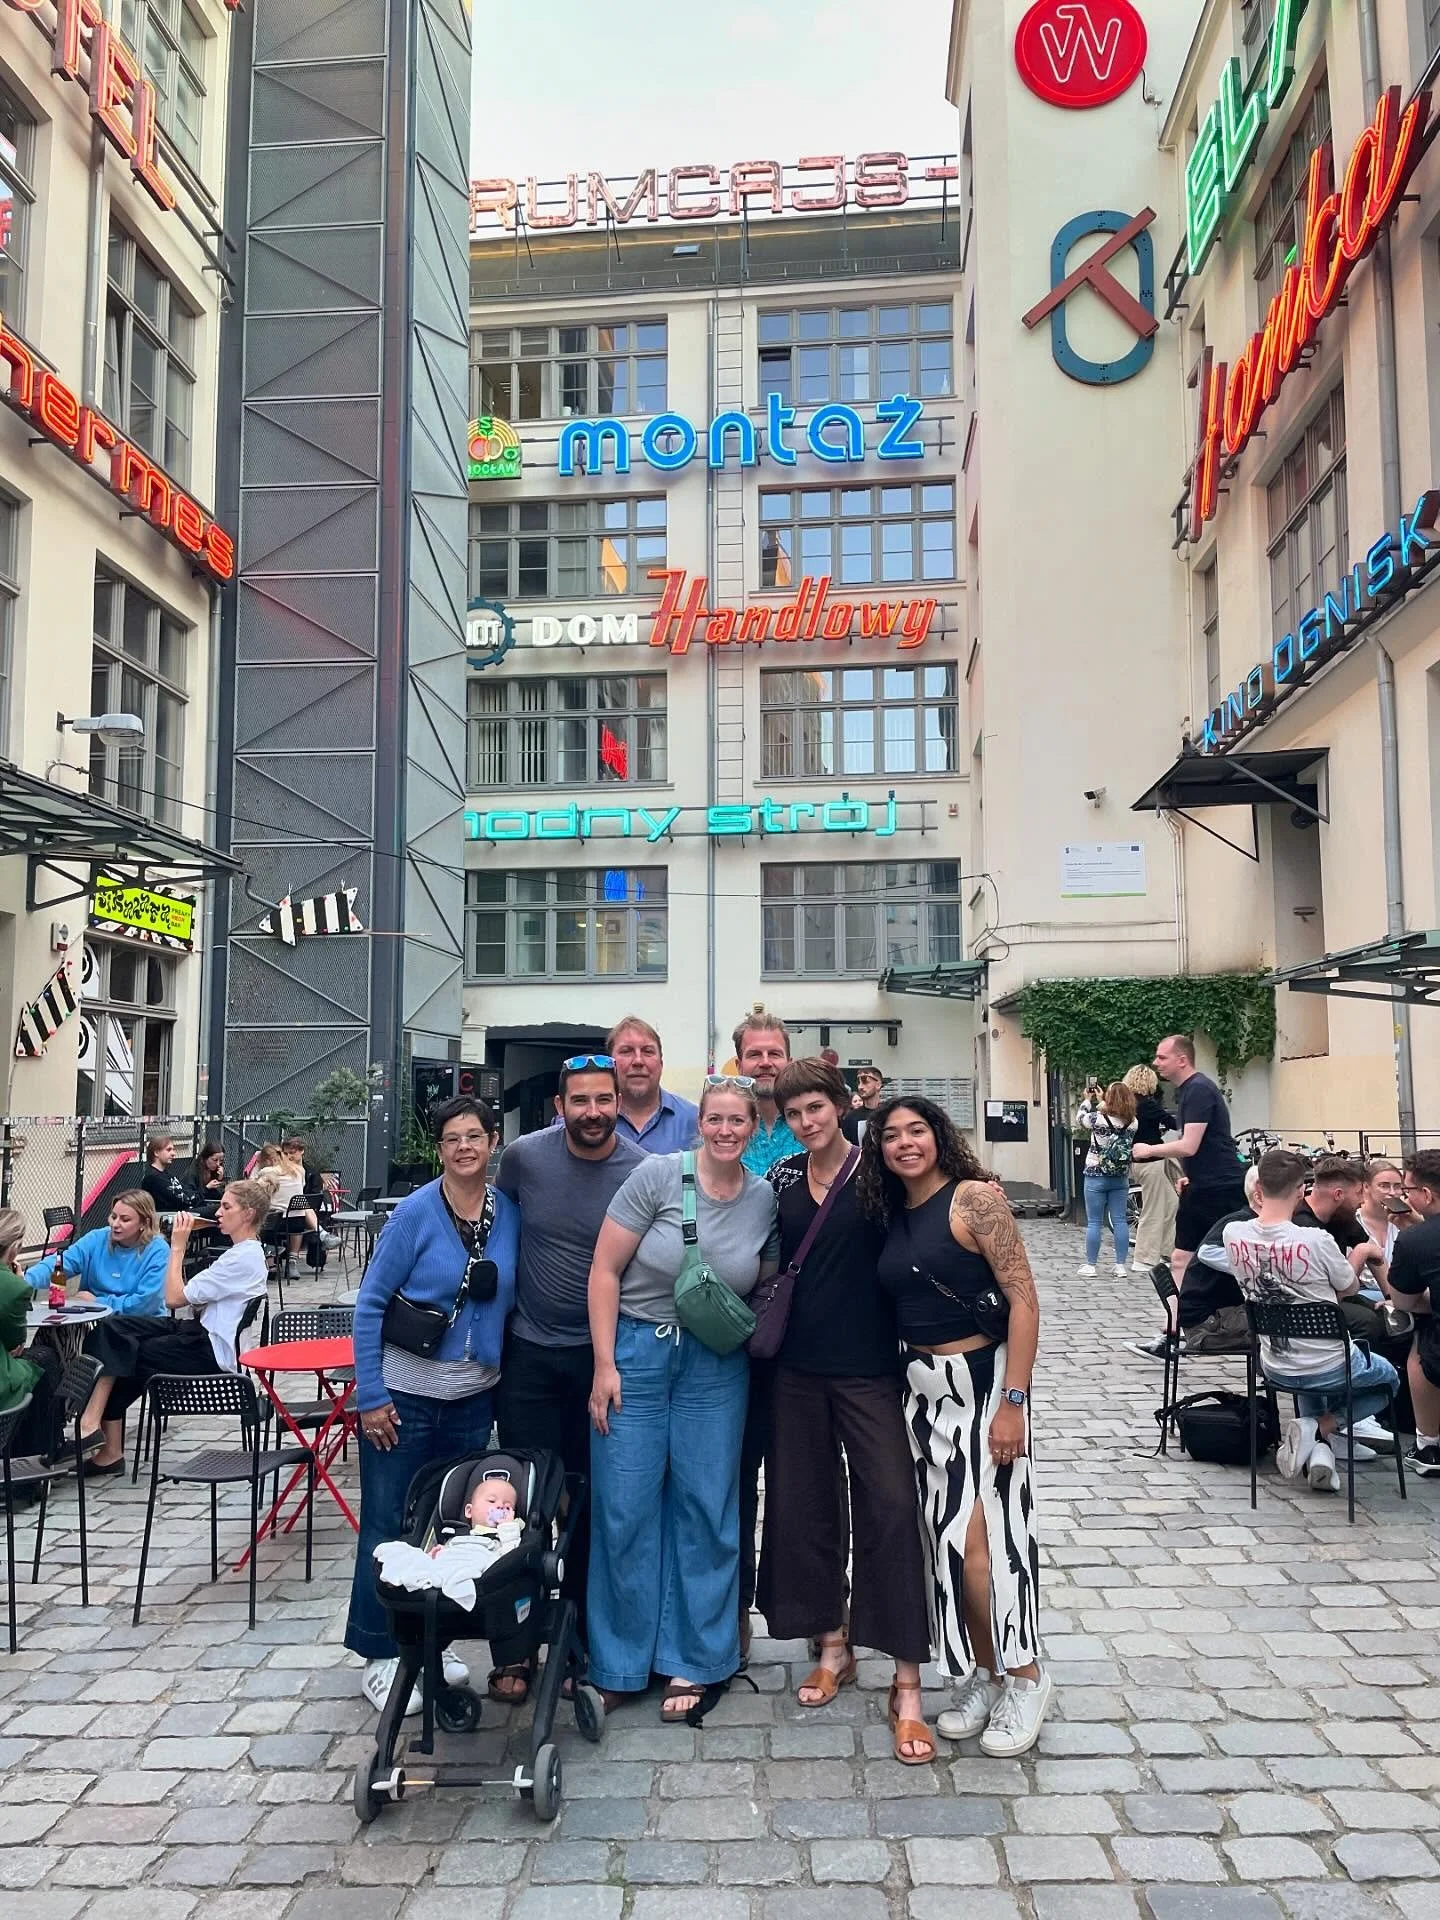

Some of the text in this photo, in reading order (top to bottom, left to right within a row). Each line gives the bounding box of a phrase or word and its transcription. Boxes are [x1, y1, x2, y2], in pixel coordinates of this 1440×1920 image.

[469, 151, 909, 233] RUMCAJS
[558, 391, 926, 477] montaż
[532, 568, 938, 655] DOM Handlowy
[1203, 663, 1268, 754] KINO
[1230, 1239, 1310, 1290] DREAMS
